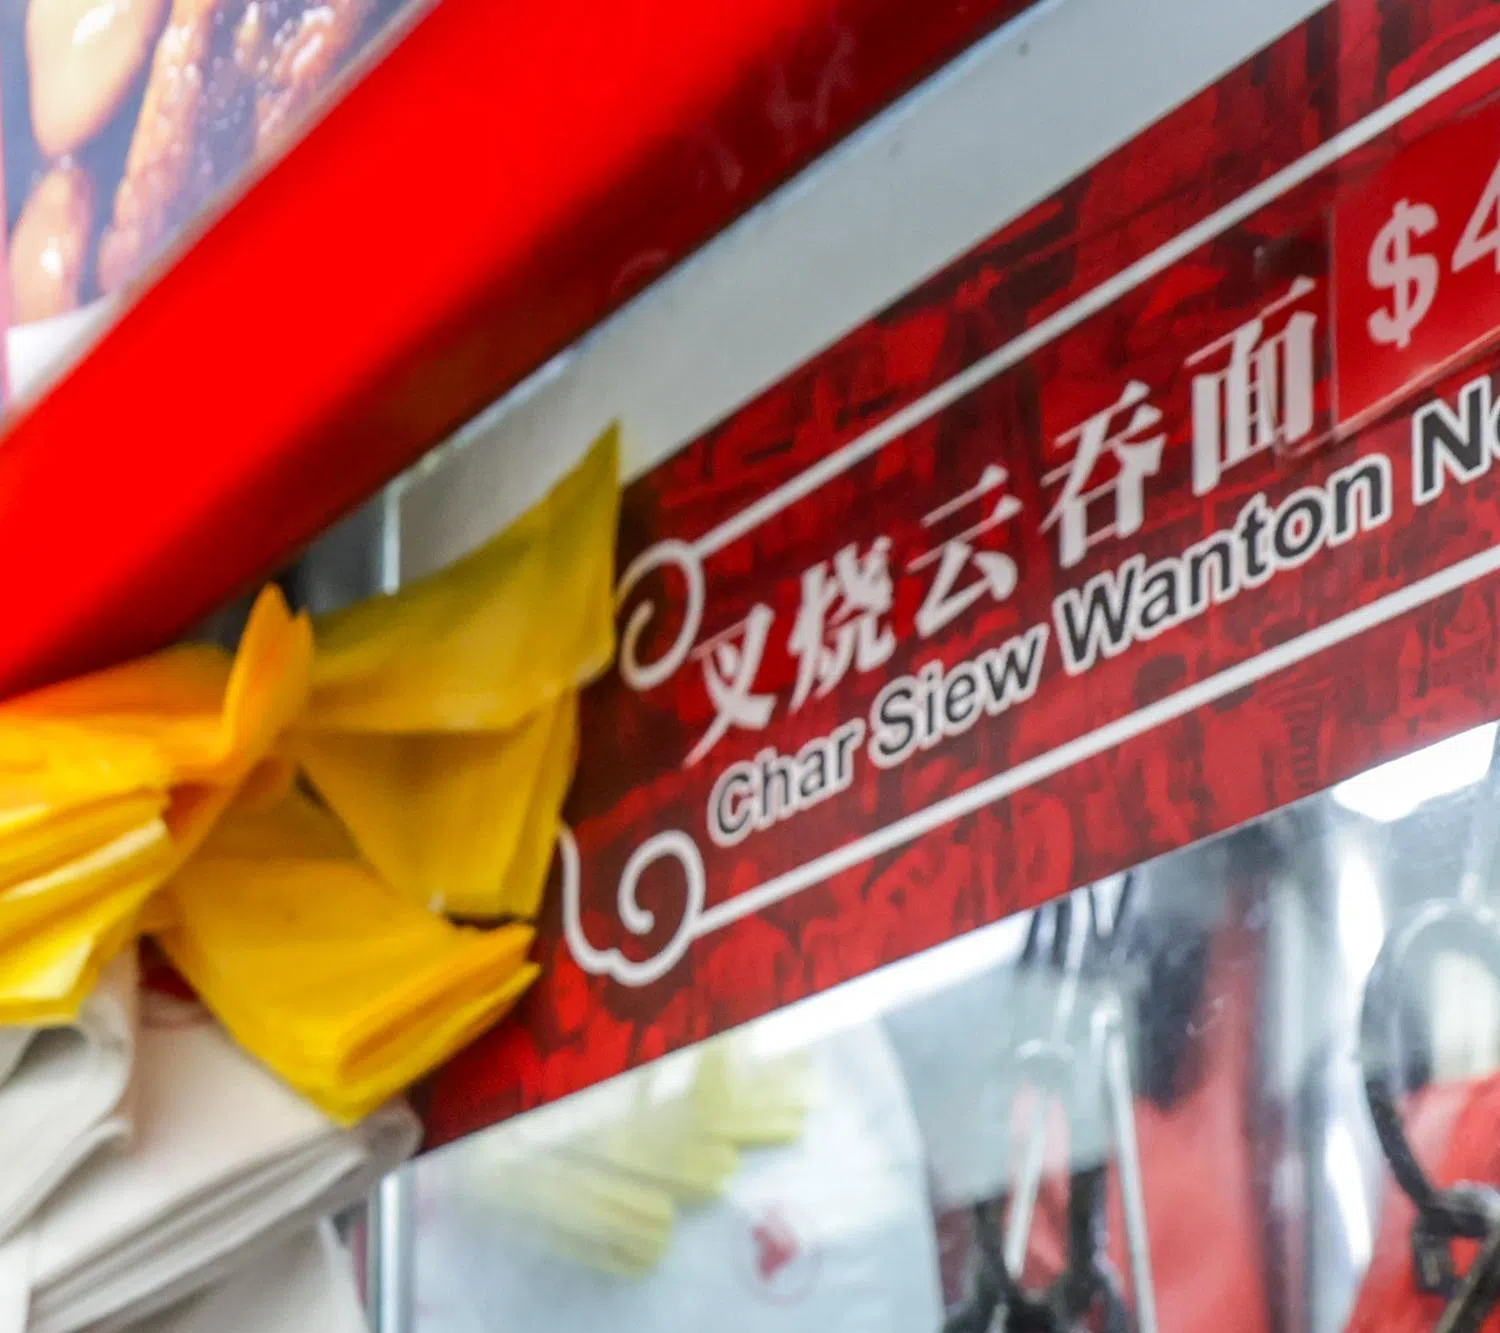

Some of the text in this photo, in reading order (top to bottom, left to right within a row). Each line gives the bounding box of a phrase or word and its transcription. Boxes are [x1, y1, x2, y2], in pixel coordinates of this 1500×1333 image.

[684, 277, 1318, 768] 叉烧云吞面
[707, 716, 863, 847] Char
[869, 620, 1049, 767] Siew
[1055, 454, 1393, 675] Wanton
